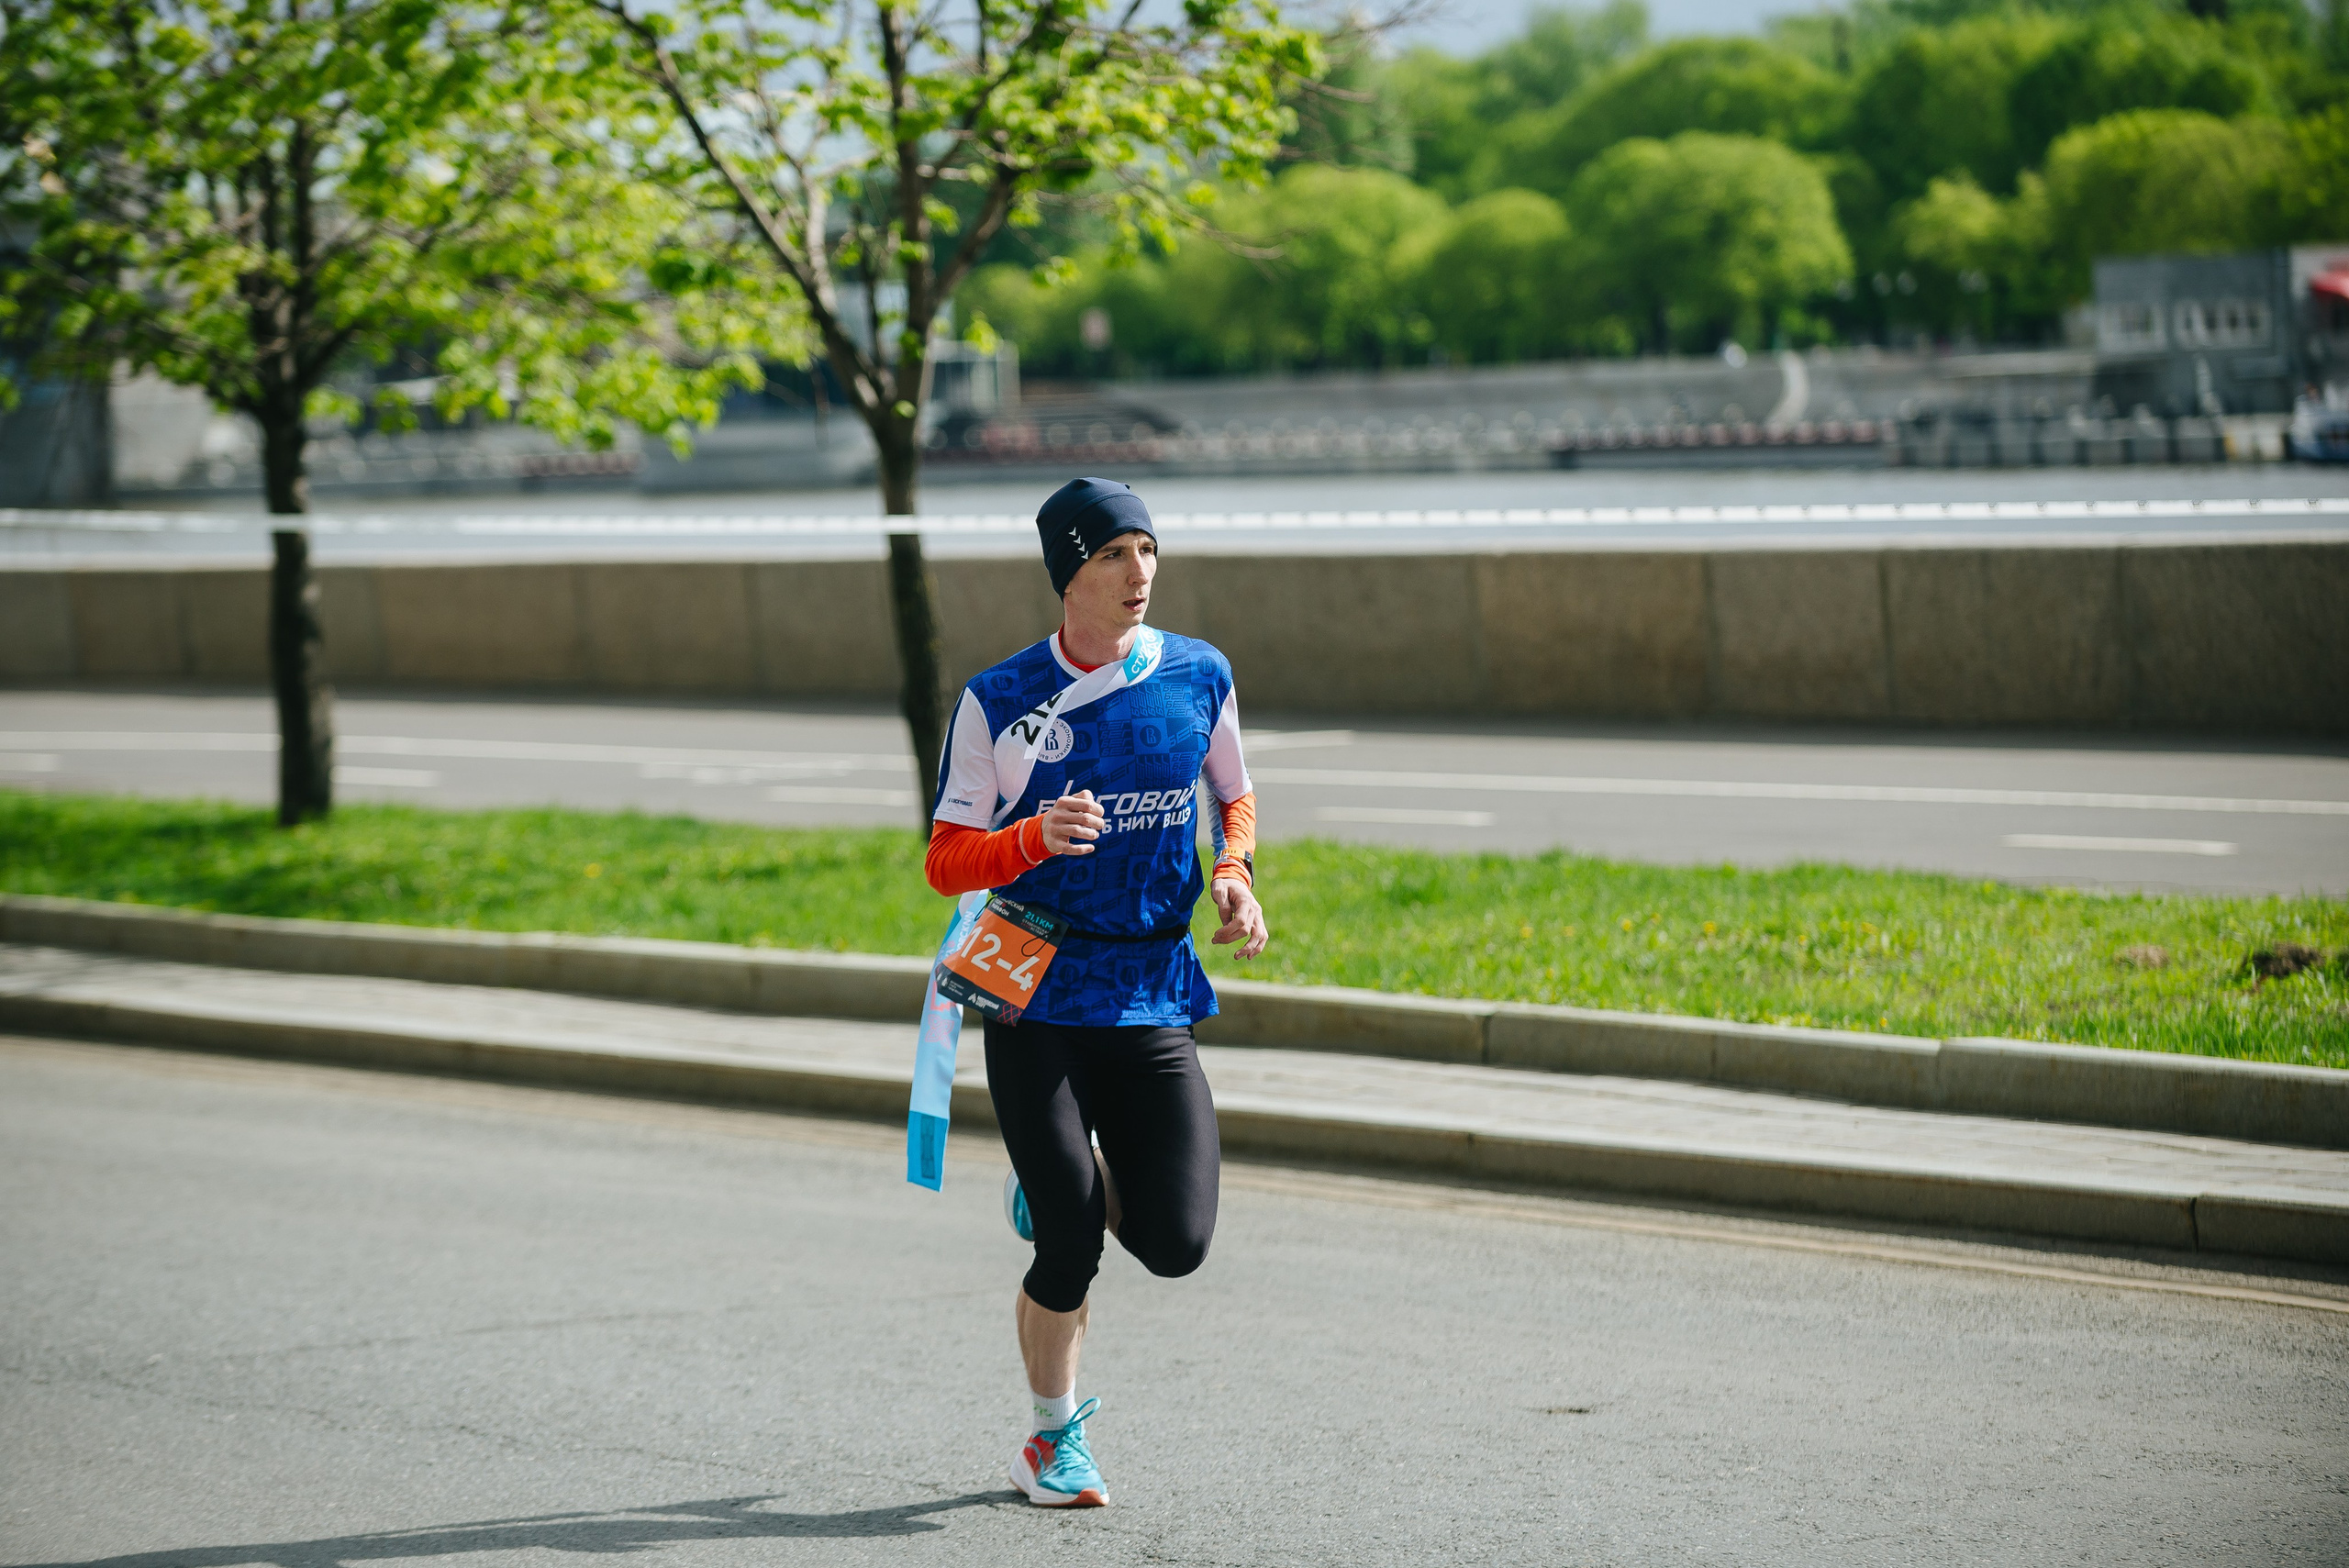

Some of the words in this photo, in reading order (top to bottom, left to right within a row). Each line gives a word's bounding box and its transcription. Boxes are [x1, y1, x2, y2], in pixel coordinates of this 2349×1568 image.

[1055, 722, 1072, 760] ЭКОНОМИКИ
[1118, 814, 1159, 833] НИУ
[1163, 806, 1192, 828] ВШЭ
[961, 925, 1041, 992] 12-4
